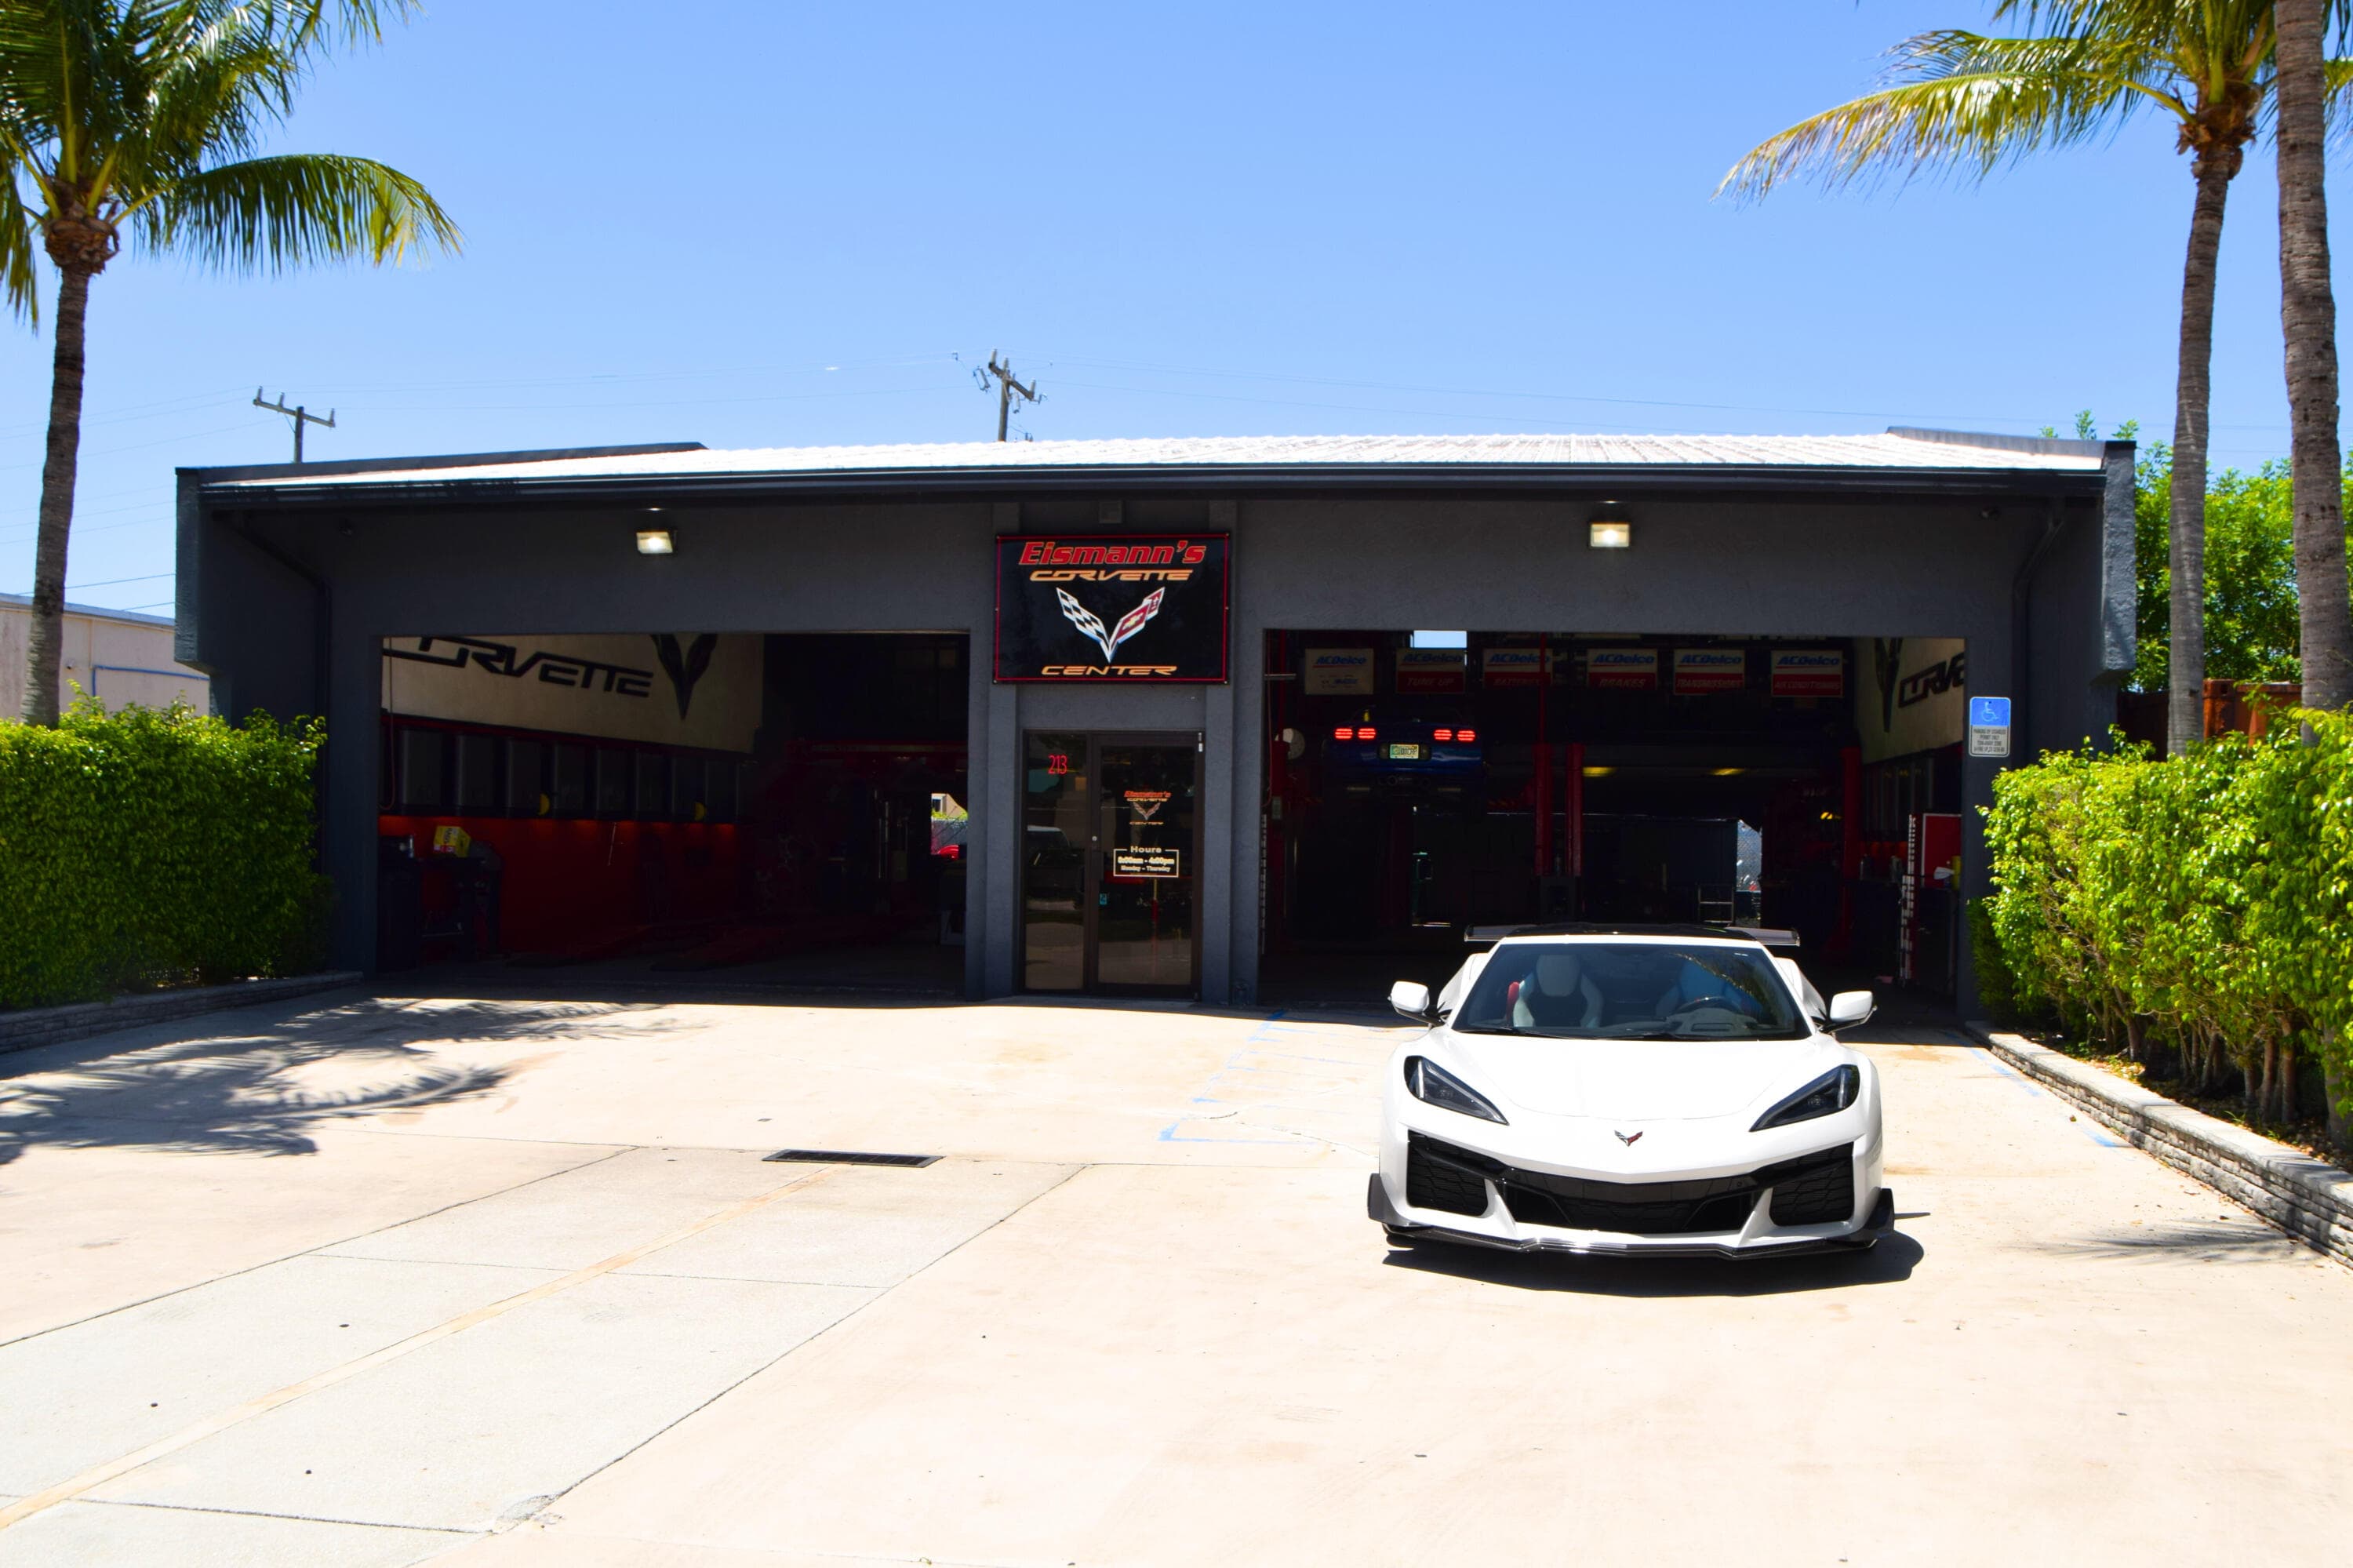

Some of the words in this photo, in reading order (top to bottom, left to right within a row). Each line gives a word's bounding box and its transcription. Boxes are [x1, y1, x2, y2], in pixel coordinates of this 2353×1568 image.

[1019, 540, 1206, 565] Eismann's
[1029, 569, 1194, 581] CORVETTE
[1315, 656, 1367, 665] ACDelco
[1402, 653, 1463, 663] ACDelco
[1593, 653, 1655, 664] ACDelco
[1680, 654, 1742, 664] ACDelco
[1777, 655, 1840, 665] ACDelco
[1041, 665, 1178, 675] CENTER
[1598, 678, 1647, 689] BRAKES
[1048, 755, 1067, 774] 213
